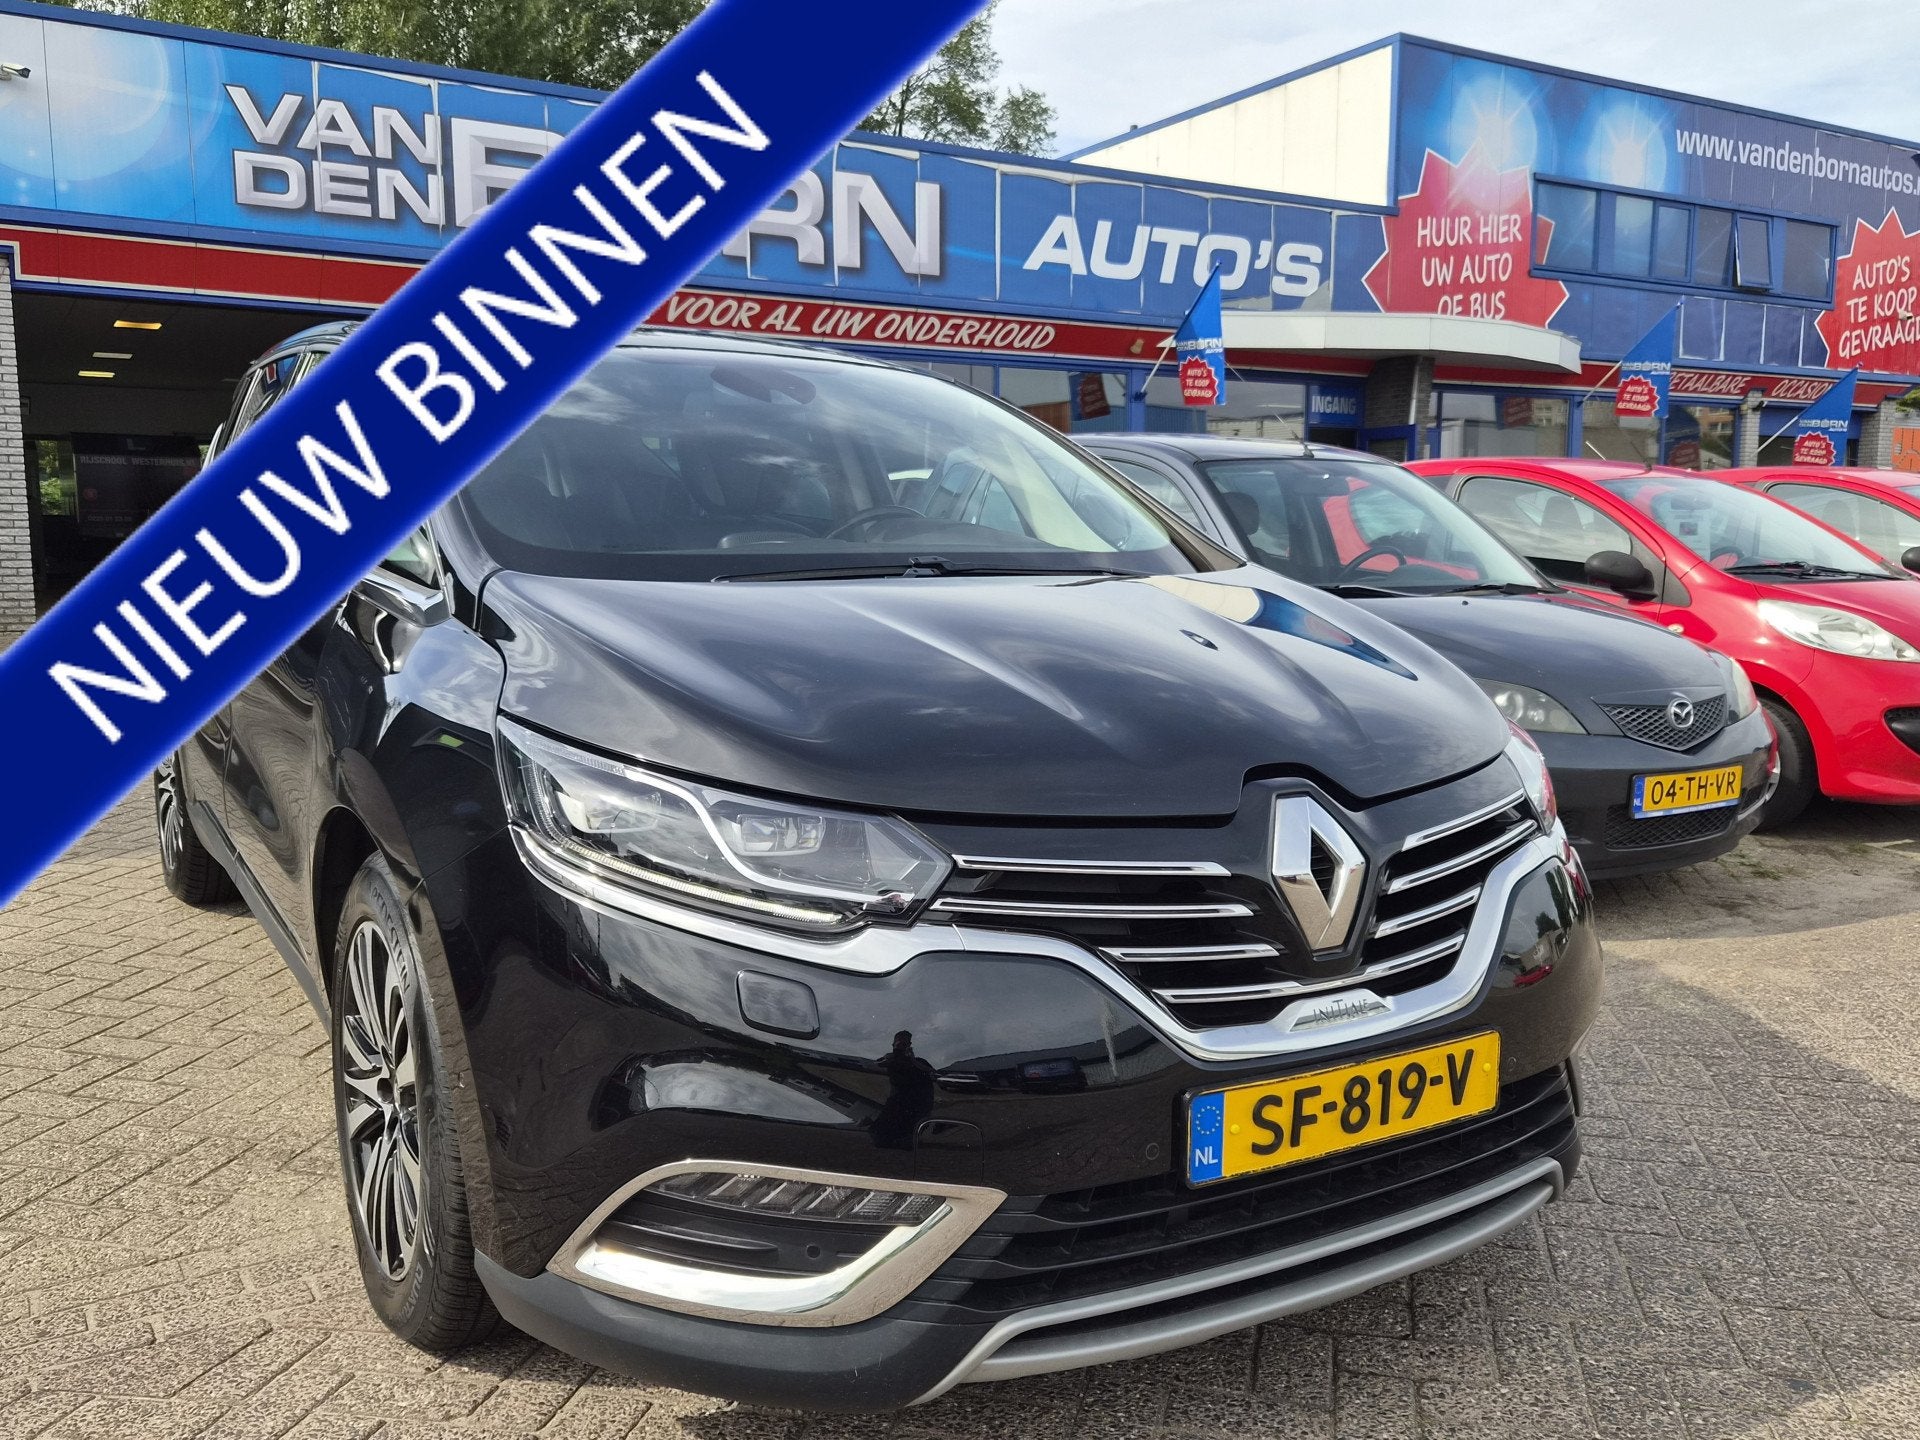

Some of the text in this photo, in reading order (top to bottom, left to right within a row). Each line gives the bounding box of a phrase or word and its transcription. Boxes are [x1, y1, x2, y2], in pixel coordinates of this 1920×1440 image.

[224, 84, 442, 165] VAN
[233, 150, 446, 226] DEN
[1417, 213, 1523, 248] HUUR HIER
[1022, 214, 1323, 298] AUTO'S
[1421, 252, 1513, 287] UW AUTO
[1852, 255, 1911, 291] AUTO'S
[667, 295, 1056, 350] VOOR AL UW ONDERHOUD
[1437, 290, 1506, 321] OF BUS
[1846, 286, 1917, 324] TE KOOP
[1669, 371, 1752, 394] ETAALBARE
[1311, 395, 1357, 415] INGANG
[1651, 771, 1737, 806] 04-TH-VR
[1251, 1049, 1474, 1156] SF-819-V
[1195, 1146, 1219, 1168] NL
